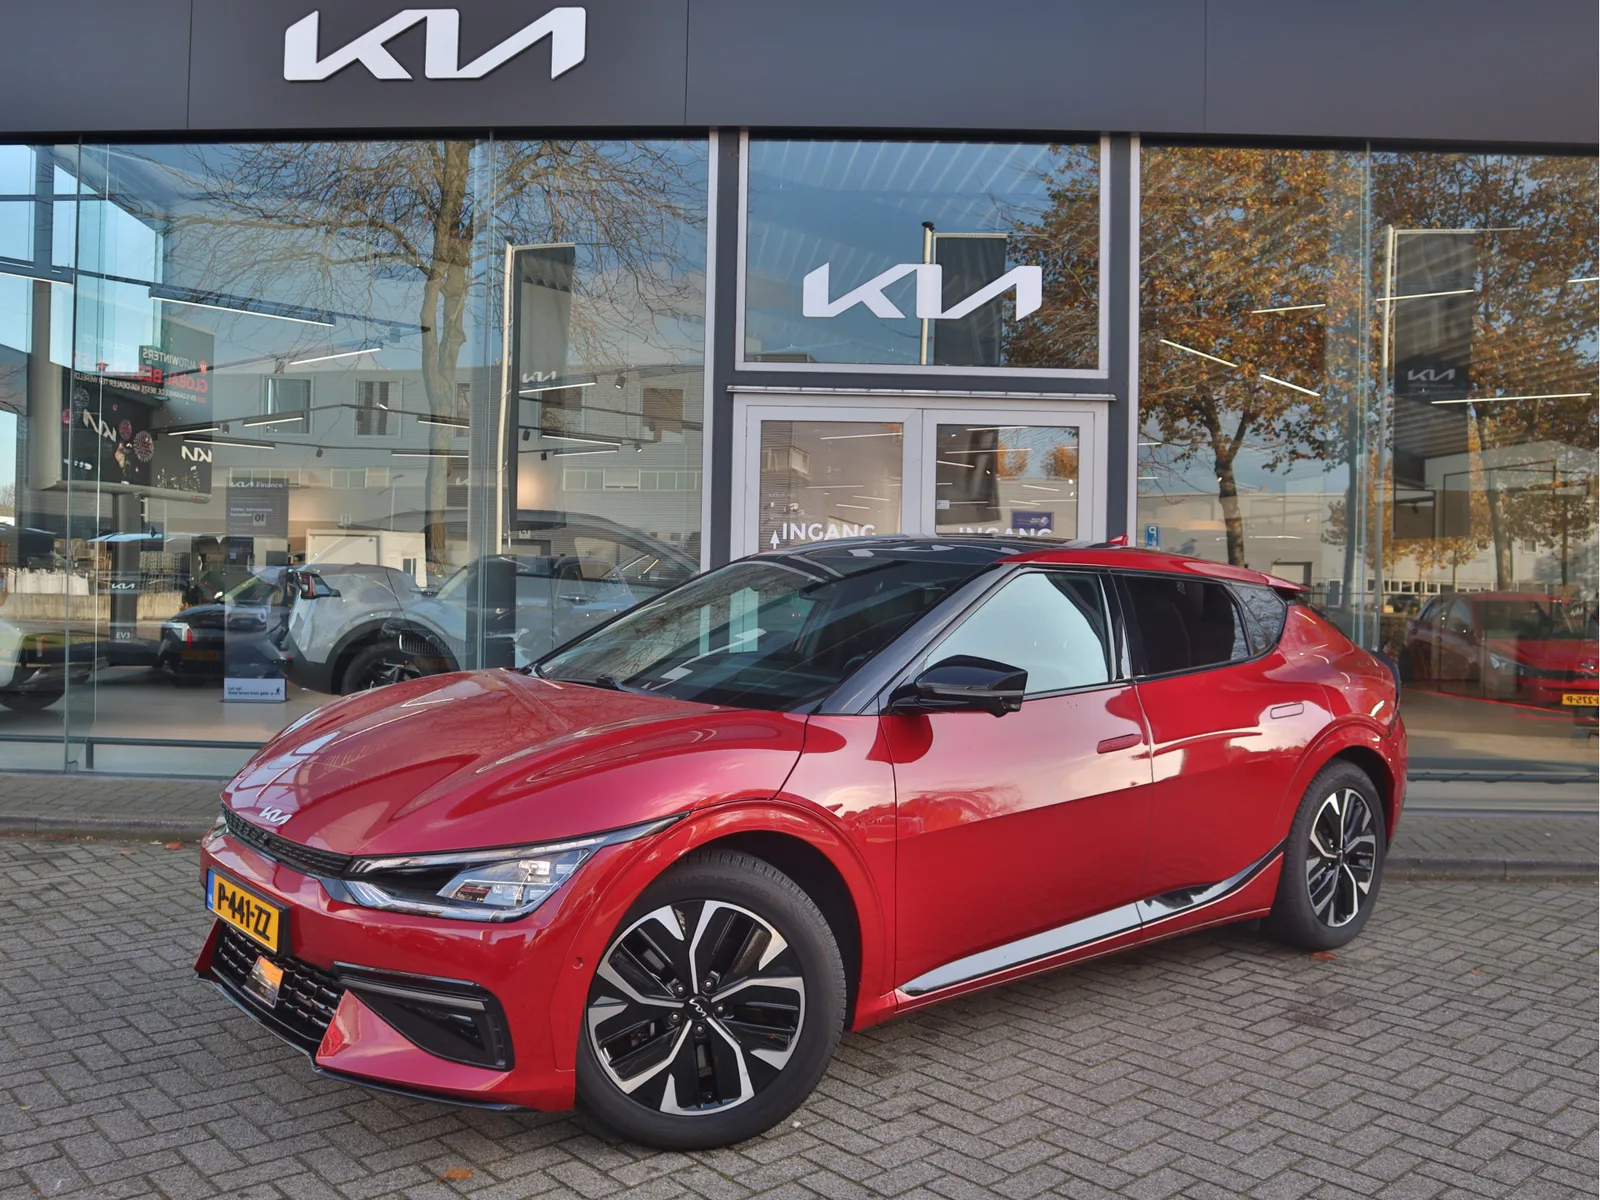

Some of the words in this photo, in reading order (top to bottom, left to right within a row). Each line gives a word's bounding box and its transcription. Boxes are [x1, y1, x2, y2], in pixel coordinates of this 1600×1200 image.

[284, 7, 586, 80] KIA
[803, 262, 1042, 322] KIA
[522, 371, 557, 383] KIA
[1408, 368, 1456, 381] KIA
[256, 481, 283, 489] Finance
[782, 523, 876, 541] INGANG
[116, 631, 131, 639] EV3
[258, 805, 292, 825] KIA
[217, 881, 272, 942] P-441-ZZ
